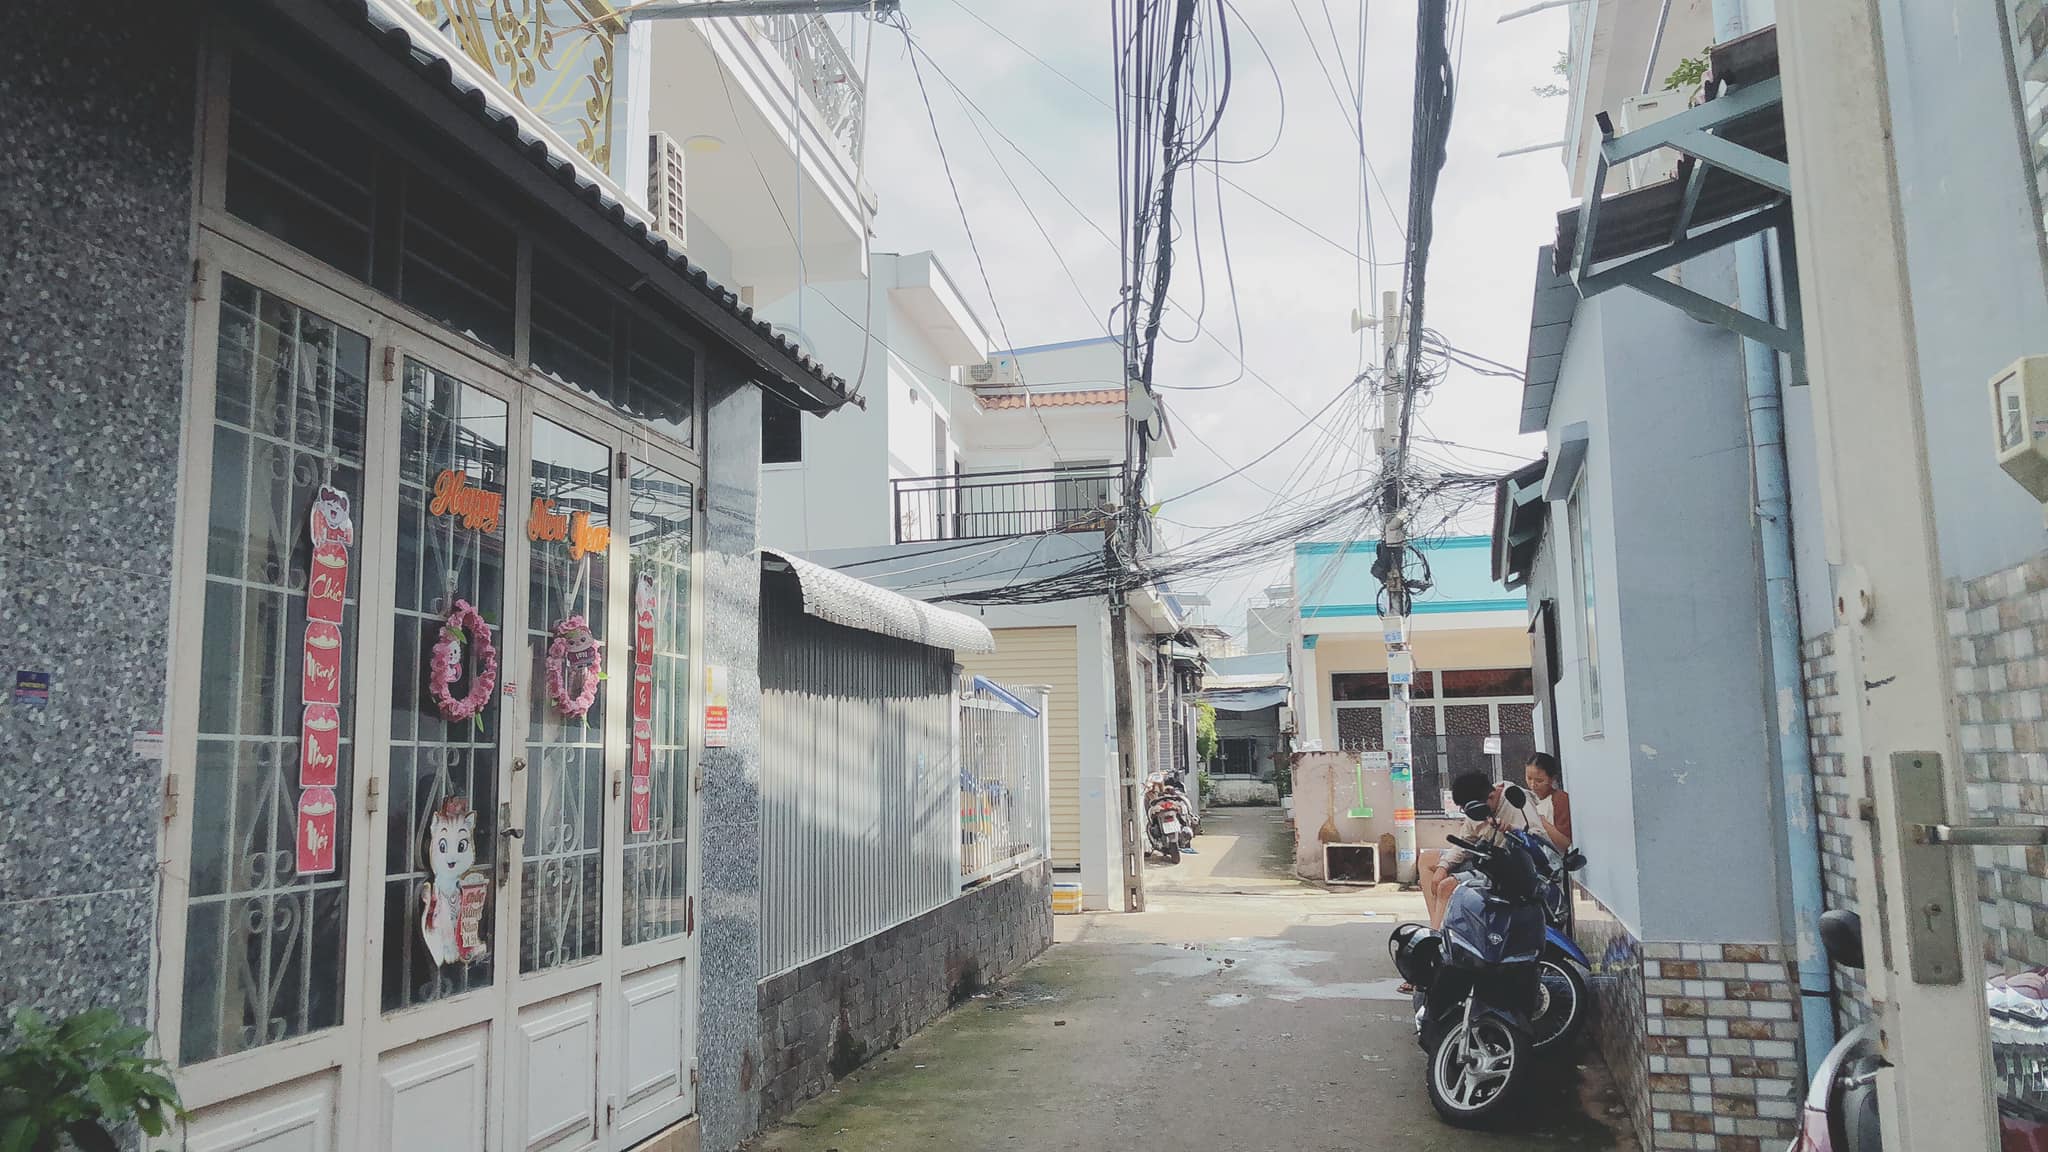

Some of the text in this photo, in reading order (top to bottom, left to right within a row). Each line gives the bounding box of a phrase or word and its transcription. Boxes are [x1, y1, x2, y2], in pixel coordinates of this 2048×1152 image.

[430, 469, 611, 560] Happy New Year
